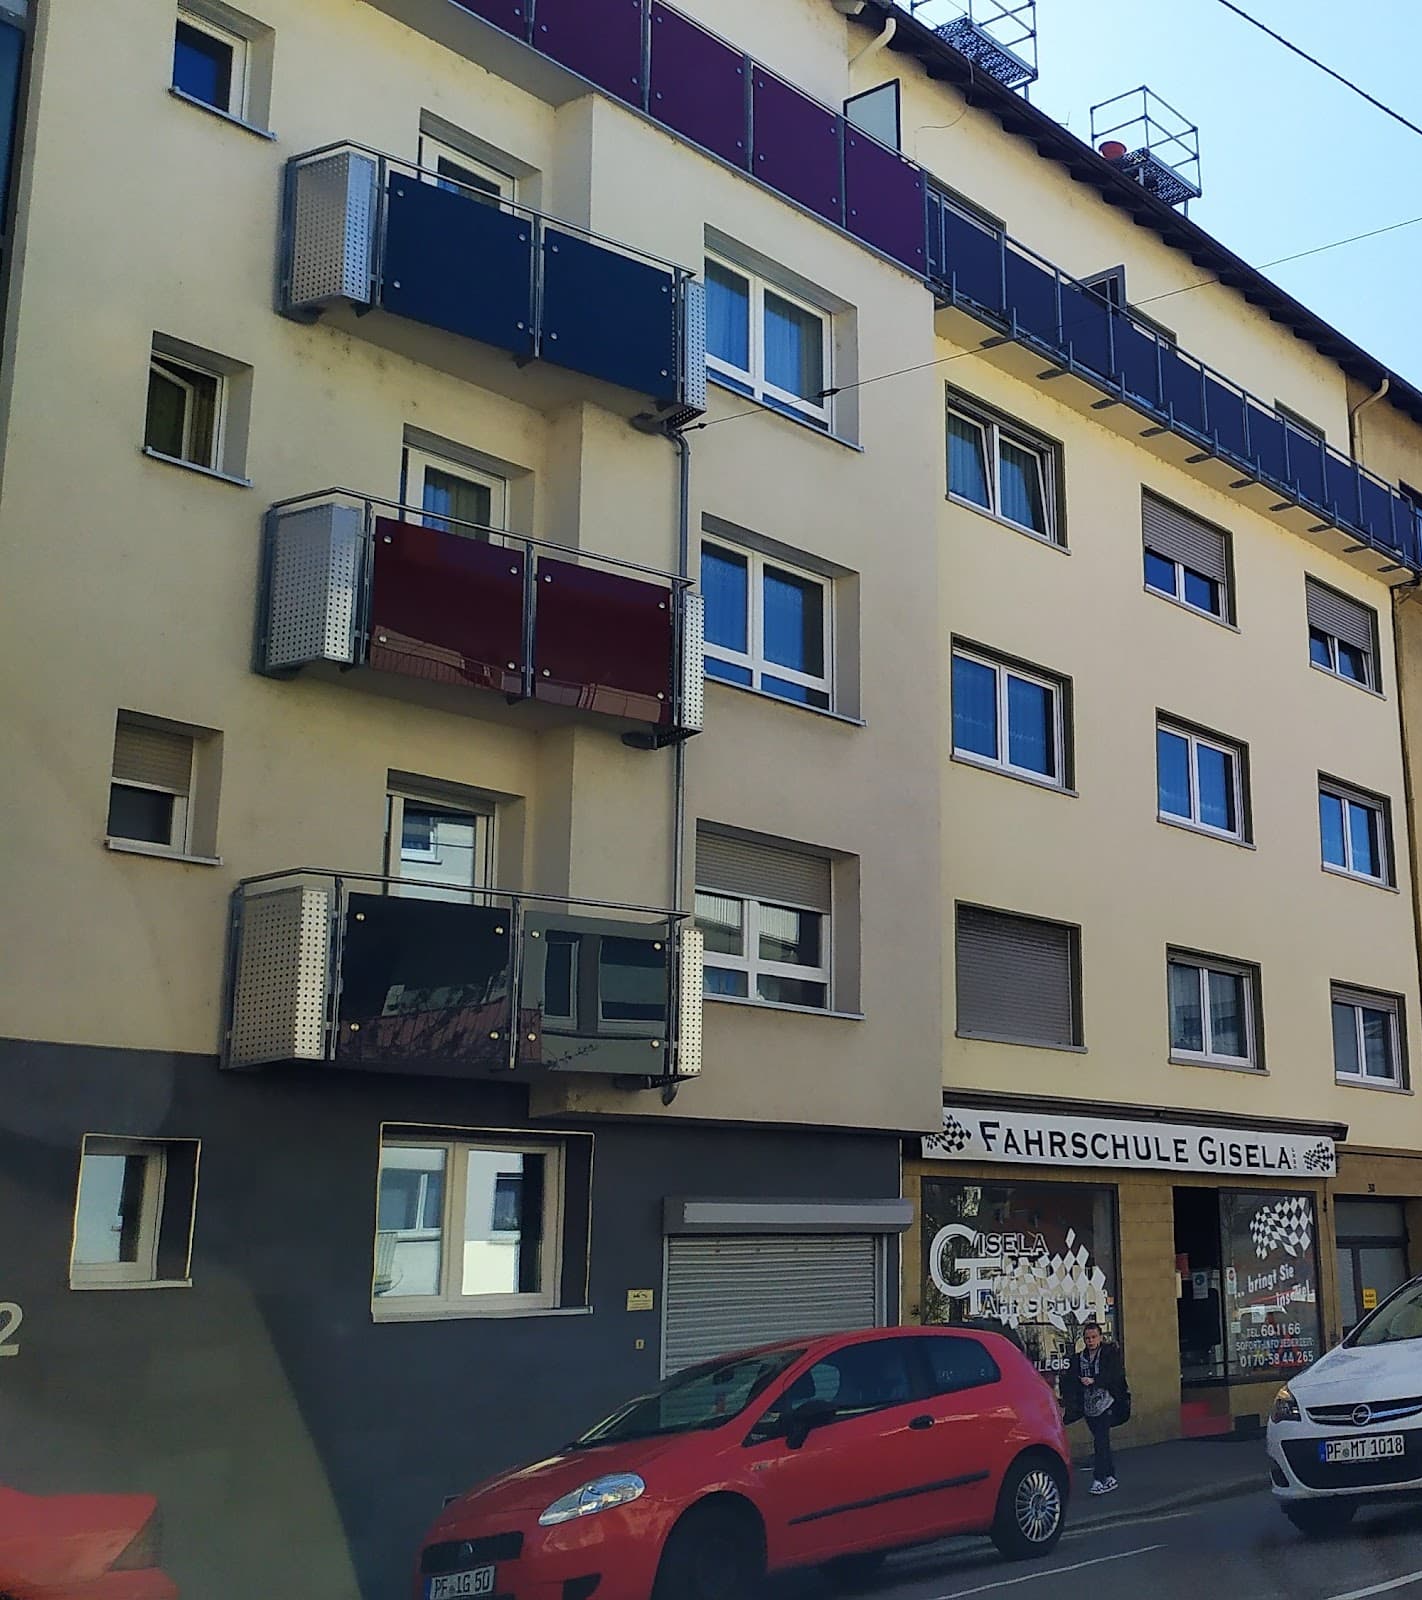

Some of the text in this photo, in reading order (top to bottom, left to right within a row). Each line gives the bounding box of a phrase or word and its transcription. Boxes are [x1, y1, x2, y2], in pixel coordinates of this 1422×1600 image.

[979, 1121, 1189, 1163] FAHRSCHULE
[1199, 1135, 1293, 1170] GISELA
[929, 1223, 1050, 1299] GISELA
[1247, 1269, 1277, 1294] bringt
[1280, 1263, 1294, 1281] Sie
[1327, 1437, 1403, 1460] PF MT 1018
[433, 1578, 448, 1599] PF
